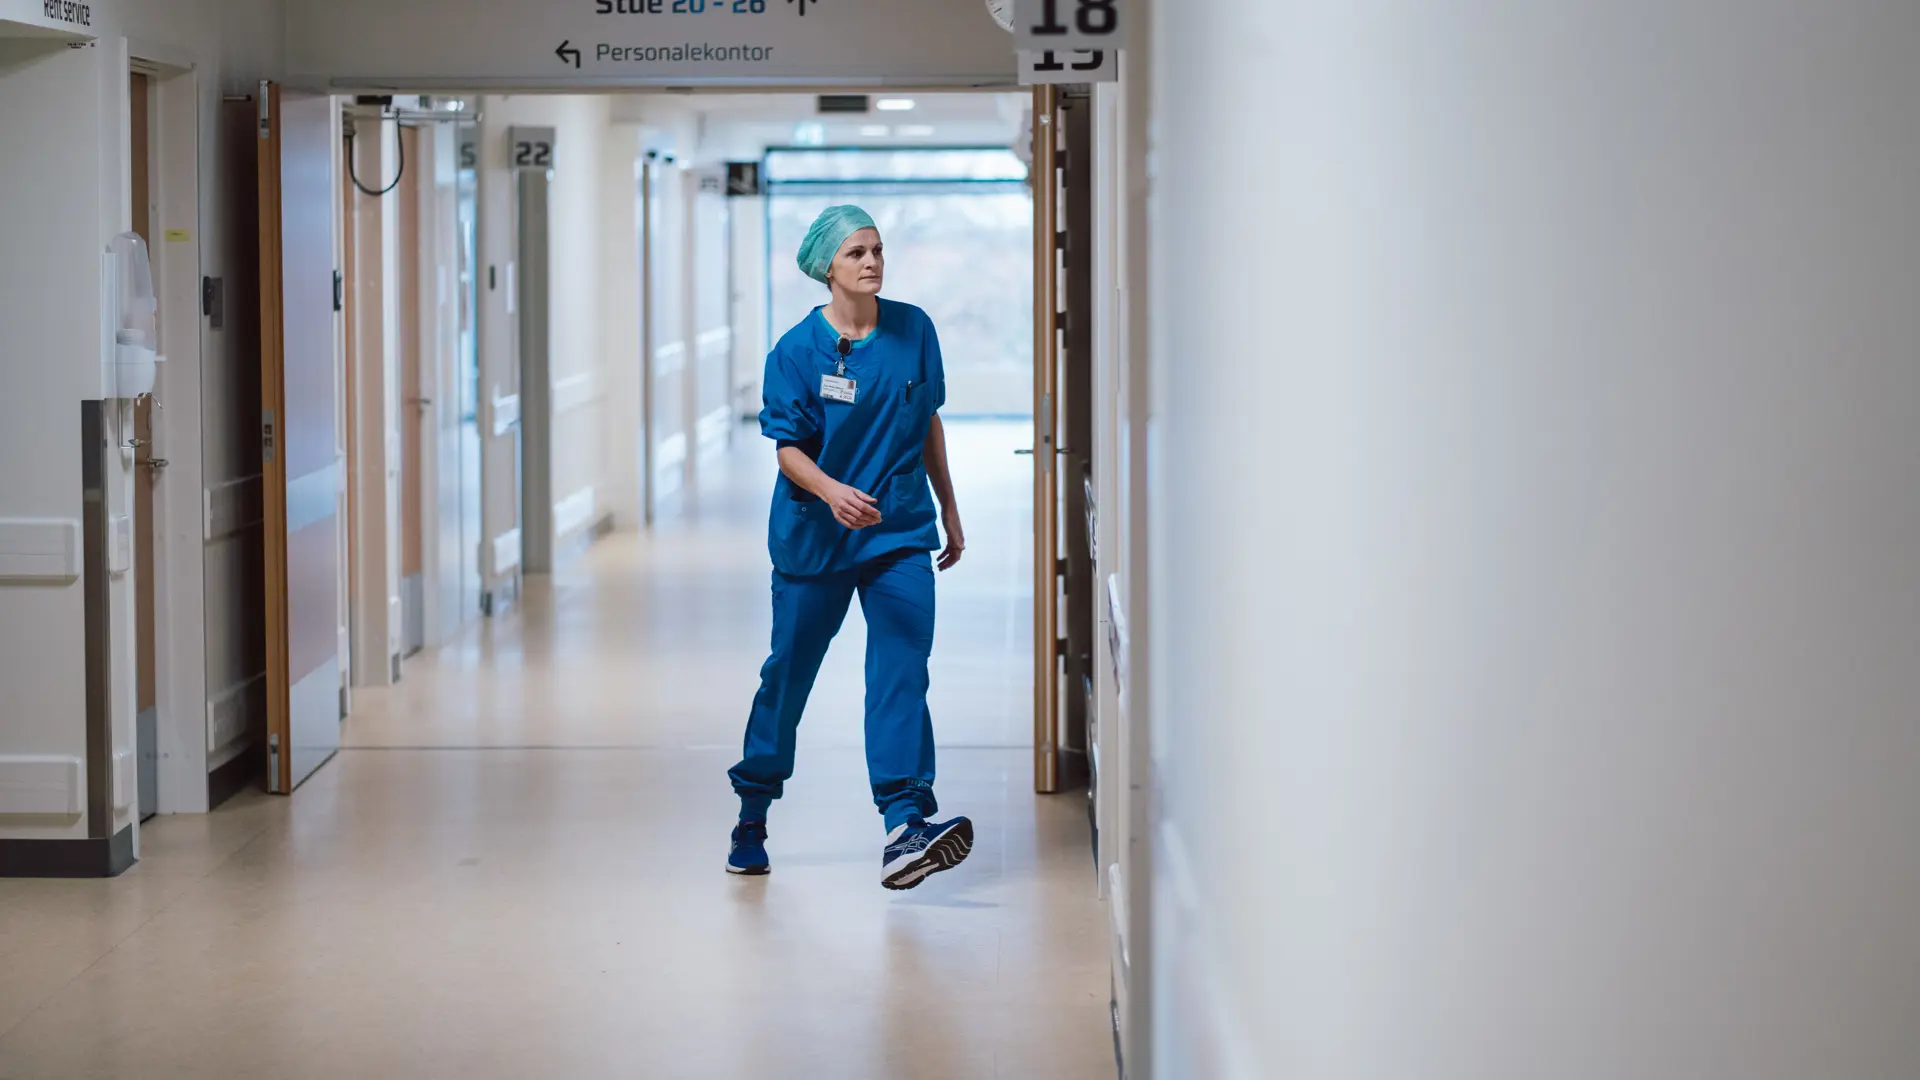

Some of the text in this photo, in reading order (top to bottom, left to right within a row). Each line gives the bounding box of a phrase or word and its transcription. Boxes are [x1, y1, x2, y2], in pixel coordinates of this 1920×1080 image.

[44, 0, 90, 26] Rent service
[596, 0, 663, 14] Stue
[1031, 0, 1117, 35] 18
[596, 43, 774, 61] Personalekontor
[516, 141, 549, 166] 22
